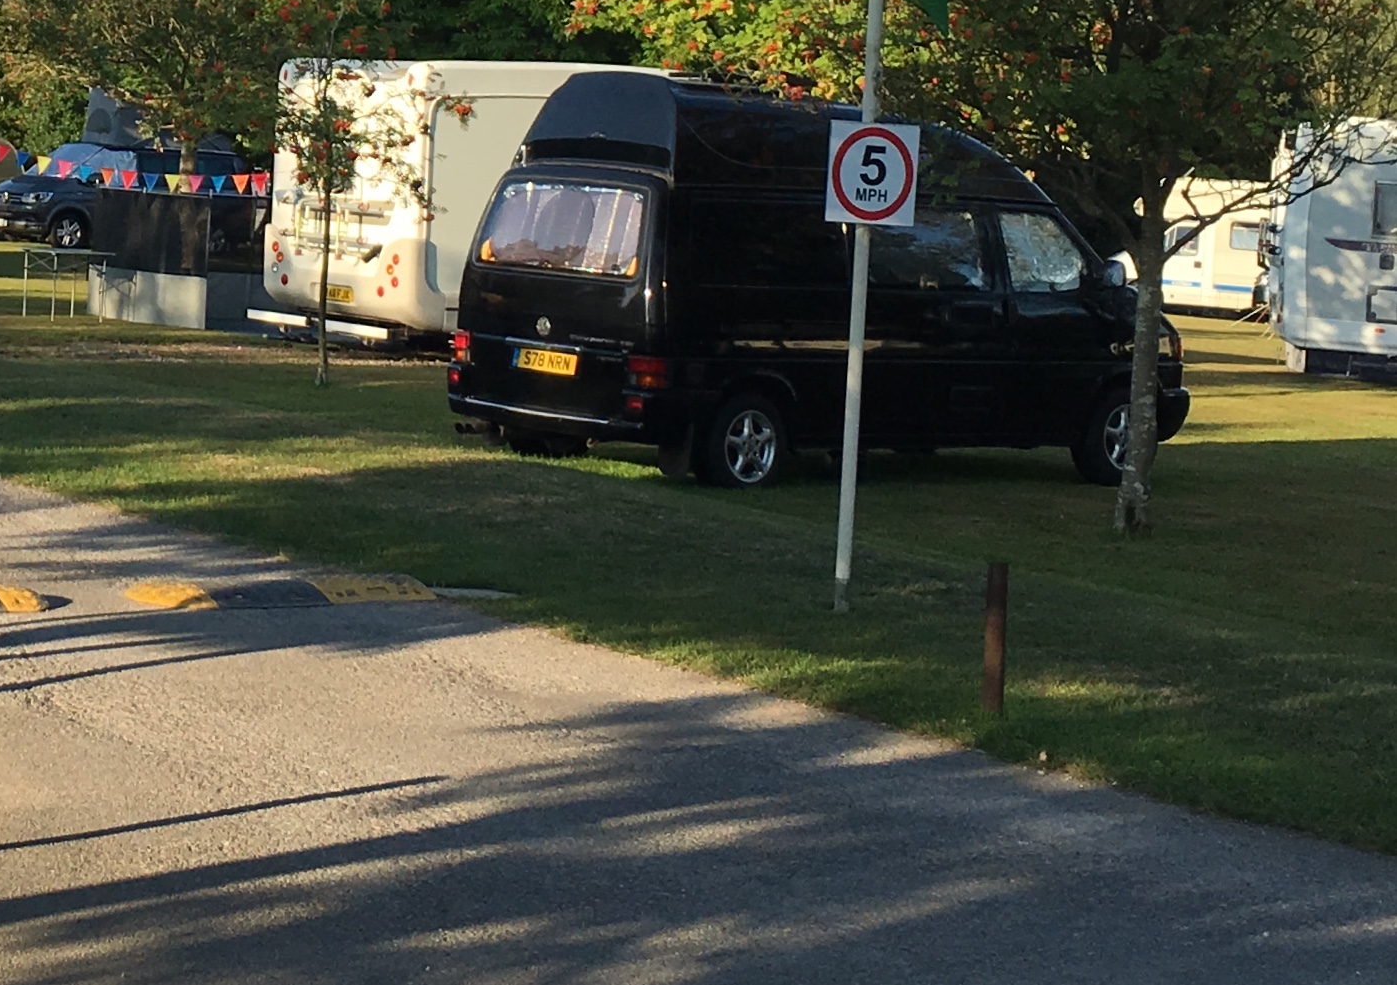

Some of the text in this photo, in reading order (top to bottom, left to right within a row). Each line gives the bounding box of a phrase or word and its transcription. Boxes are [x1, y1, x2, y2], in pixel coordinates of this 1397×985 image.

[859, 144, 886, 186] 5
[855, 187, 888, 203] MPH
[523, 350, 571, 371] S78 NRN
